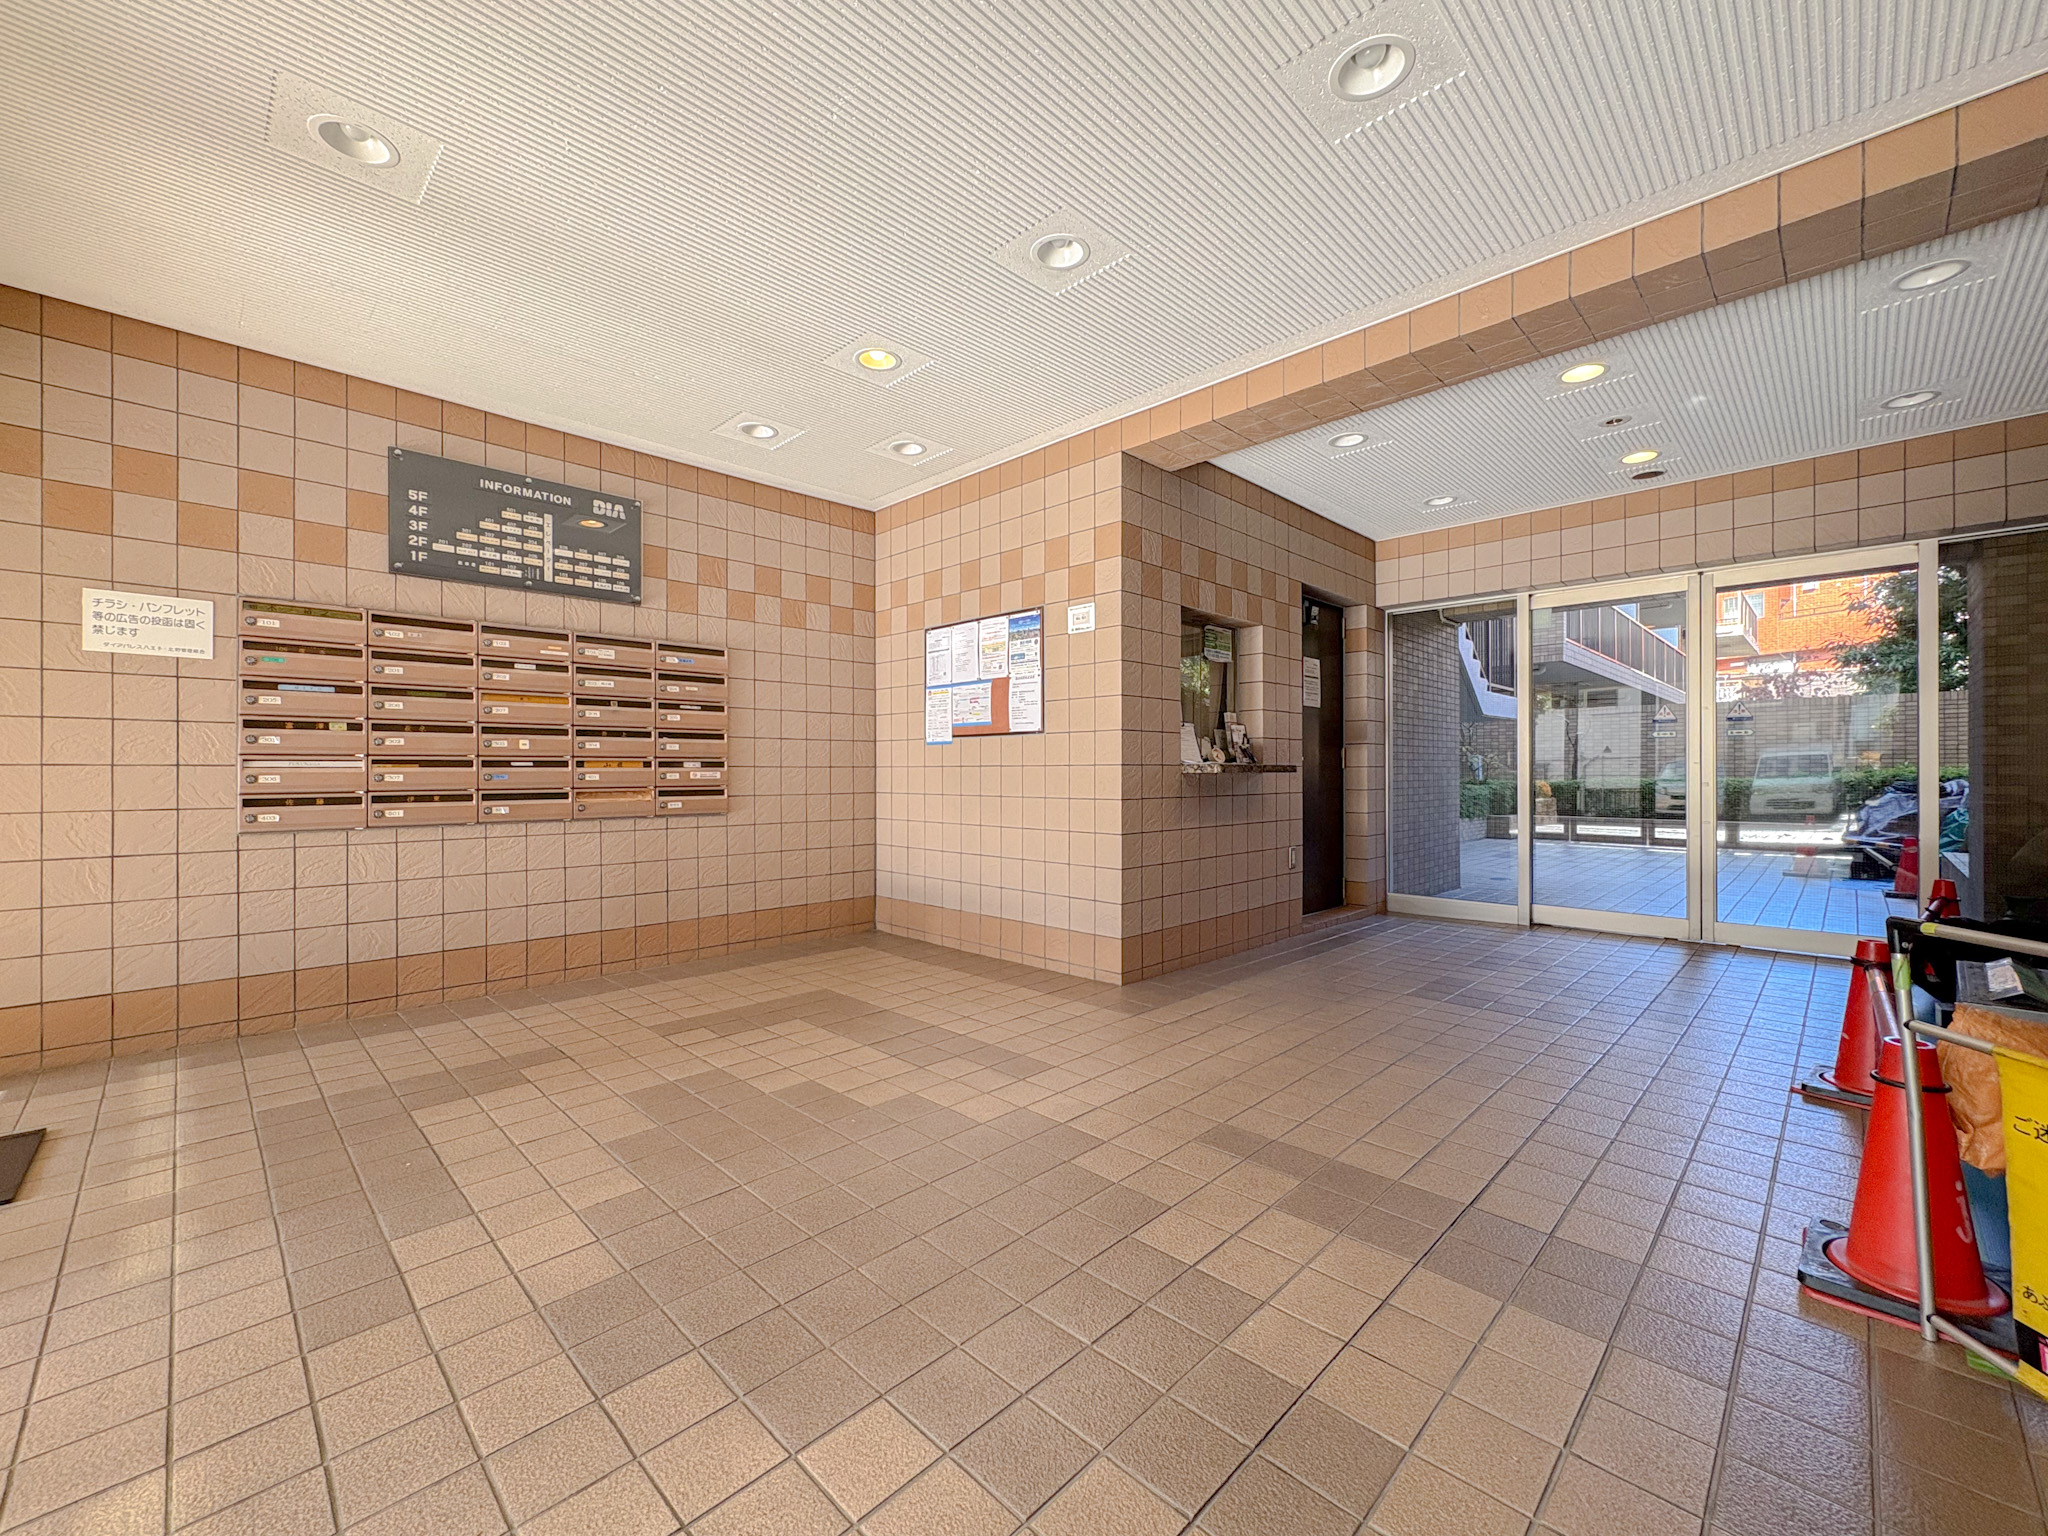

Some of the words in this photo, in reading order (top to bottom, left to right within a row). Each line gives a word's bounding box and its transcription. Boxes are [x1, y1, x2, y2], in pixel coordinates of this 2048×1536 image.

[408, 489, 428, 502] 5F
[479, 478, 572, 506] INFORMATION
[408, 505, 428, 517] 4F
[593, 499, 626, 520] DIA
[408, 520, 428, 532] 3F
[408, 535, 428, 547] 2F
[410, 550, 428, 562] 1F
[92, 597, 205, 617] チラシ・パンフレット
[92, 611, 205, 630] 等の広告の投函は固く
[92, 625, 140, 638] 禁じます
